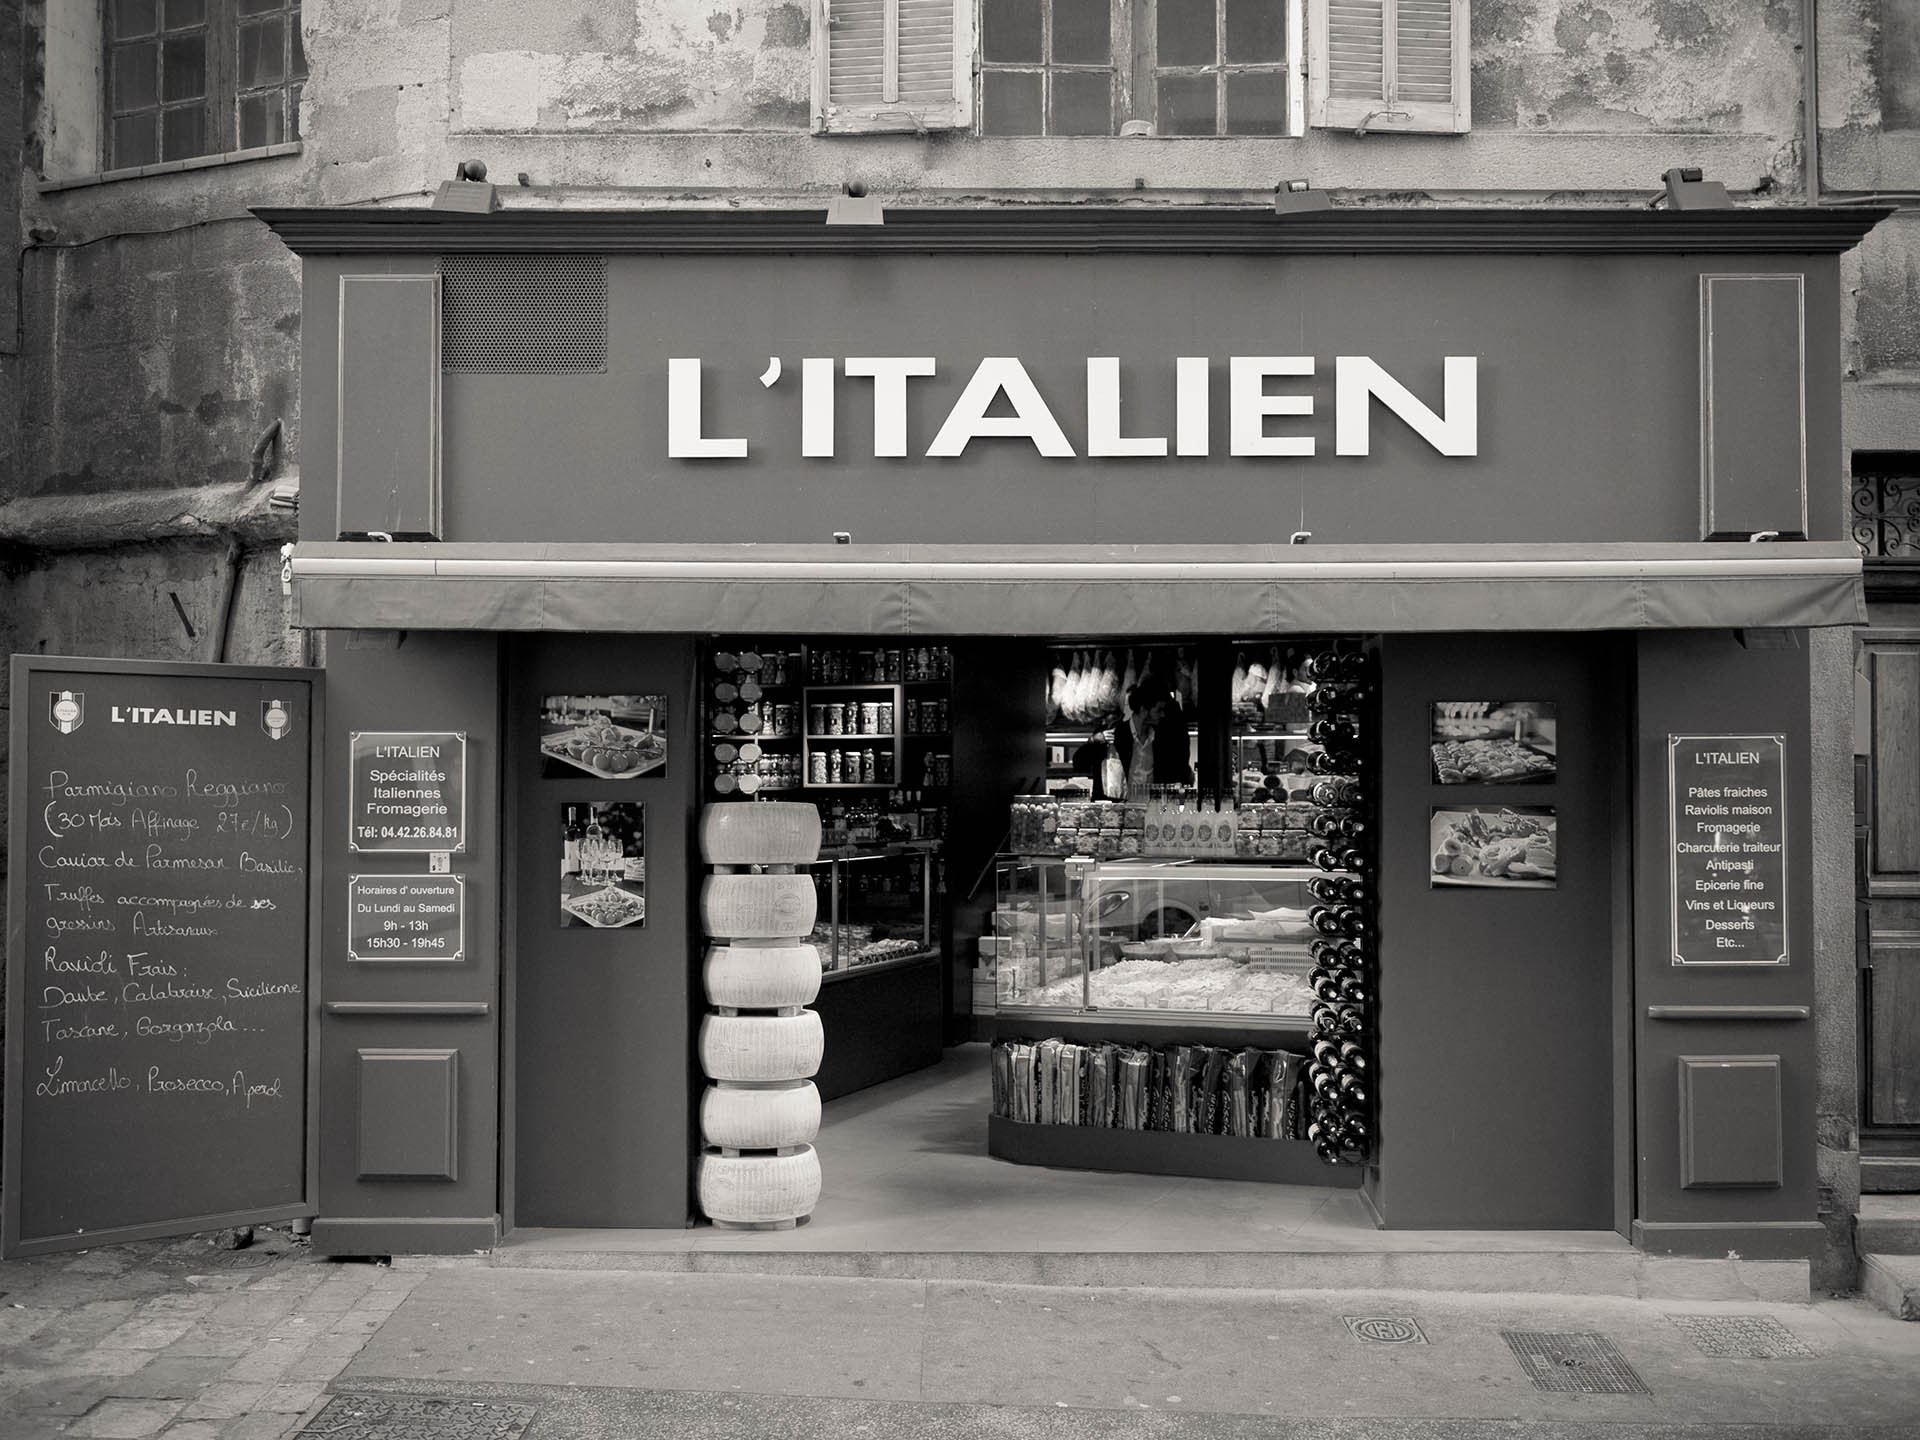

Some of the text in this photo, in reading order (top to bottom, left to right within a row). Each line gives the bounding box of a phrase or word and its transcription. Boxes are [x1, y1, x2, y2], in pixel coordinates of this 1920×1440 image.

[375, 745, 441, 759] L'ITALIEN
[1695, 752, 1761, 765] L'ITALIEN
[369, 769, 446, 784] Spécialités
[42, 768, 286, 809] Parmigiano Reggiano
[373, 786, 441, 799] Italiennes
[1688, 786, 1768, 798] Pâtes fraiches
[366, 802, 448, 817] Fromagerie
[1684, 804, 1772, 816] Raviolis maison
[132, 807, 200, 842] Affinage
[1696, 822, 1761, 836] Fromagerie
[357, 825, 458, 839] Tél: 04.42.26.84.81
[1676, 841, 1782, 854] Charcuterie traiteur
[38, 845, 112, 870] Caviar
[115, 850, 142, 869] de
[145, 843, 231, 870] Parmesan
[1705, 859, 1755, 874] Antipasti
[357, 885, 397, 896] Horaires
[410, 886, 455, 896] ouverture
[1695, 879, 1765, 893] Epicerie fine
[43, 883, 105, 911] Truffes
[225, 893, 247, 909] de
[250, 898, 278, 911] ses
[357, 903, 456, 914] Du Lundi au Samedi
[1685, 899, 1775, 913] Vins et Liqueurs
[133, 910, 218, 937] Artisanaux
[383, 920, 398, 932] 9h
[408, 920, 429, 932] 13h
[1705, 919, 1755, 931] Desserts
[366, 938, 400, 949] 15h30
[411, 938, 446, 949] 19h45
[1716, 936, 1746, 949] Etc...
[44, 945, 118, 975] Ravioli
[232, 1070, 283, 1110] Aperol
